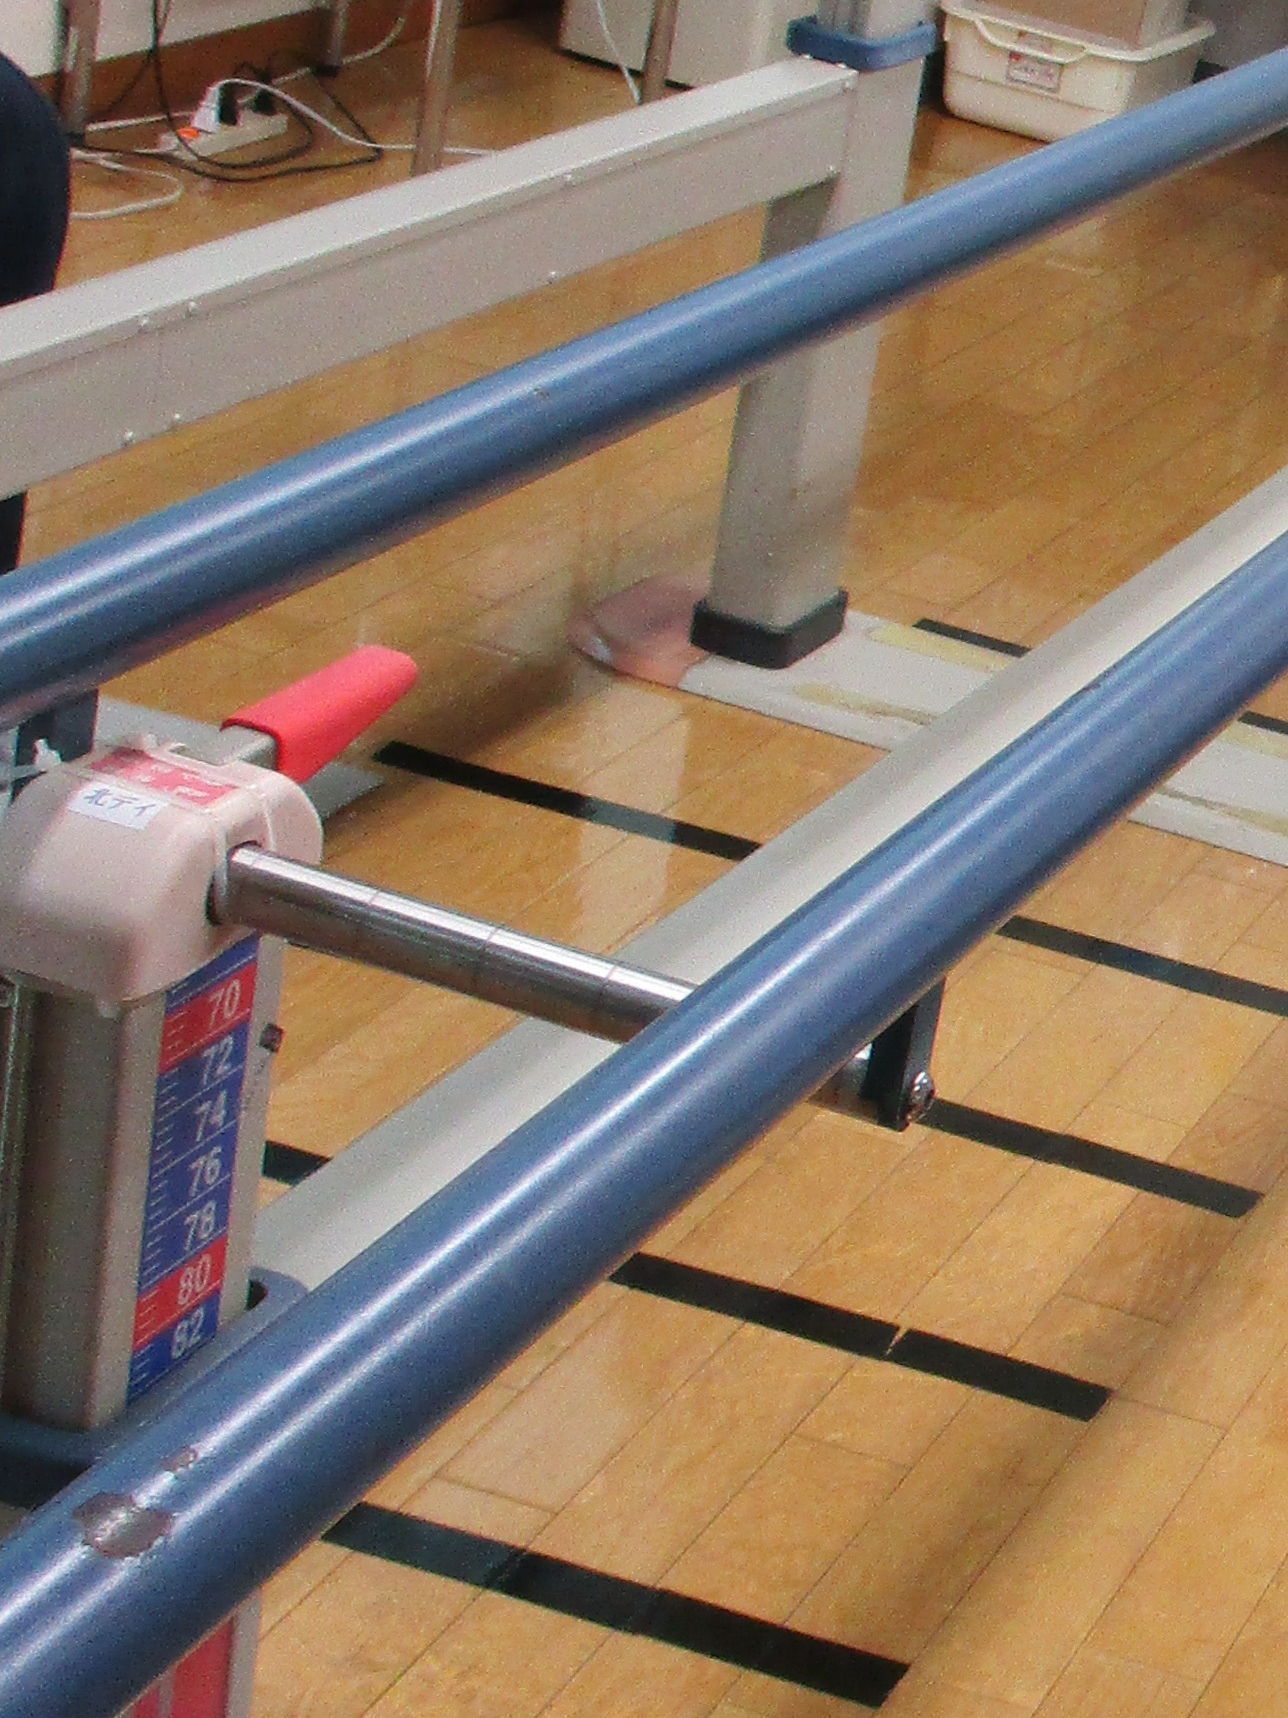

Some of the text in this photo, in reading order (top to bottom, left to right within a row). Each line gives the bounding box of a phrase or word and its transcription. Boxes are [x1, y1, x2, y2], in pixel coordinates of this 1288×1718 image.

[208, 978, 242, 1030] 70
[202, 1035, 234, 1085] 72
[194, 1088, 227, 1143] 74
[188, 1145, 223, 1198] 76
[183, 1199, 217, 1252] 78
[176, 1252, 212, 1306] 80
[171, 1306, 205, 1360] 82
